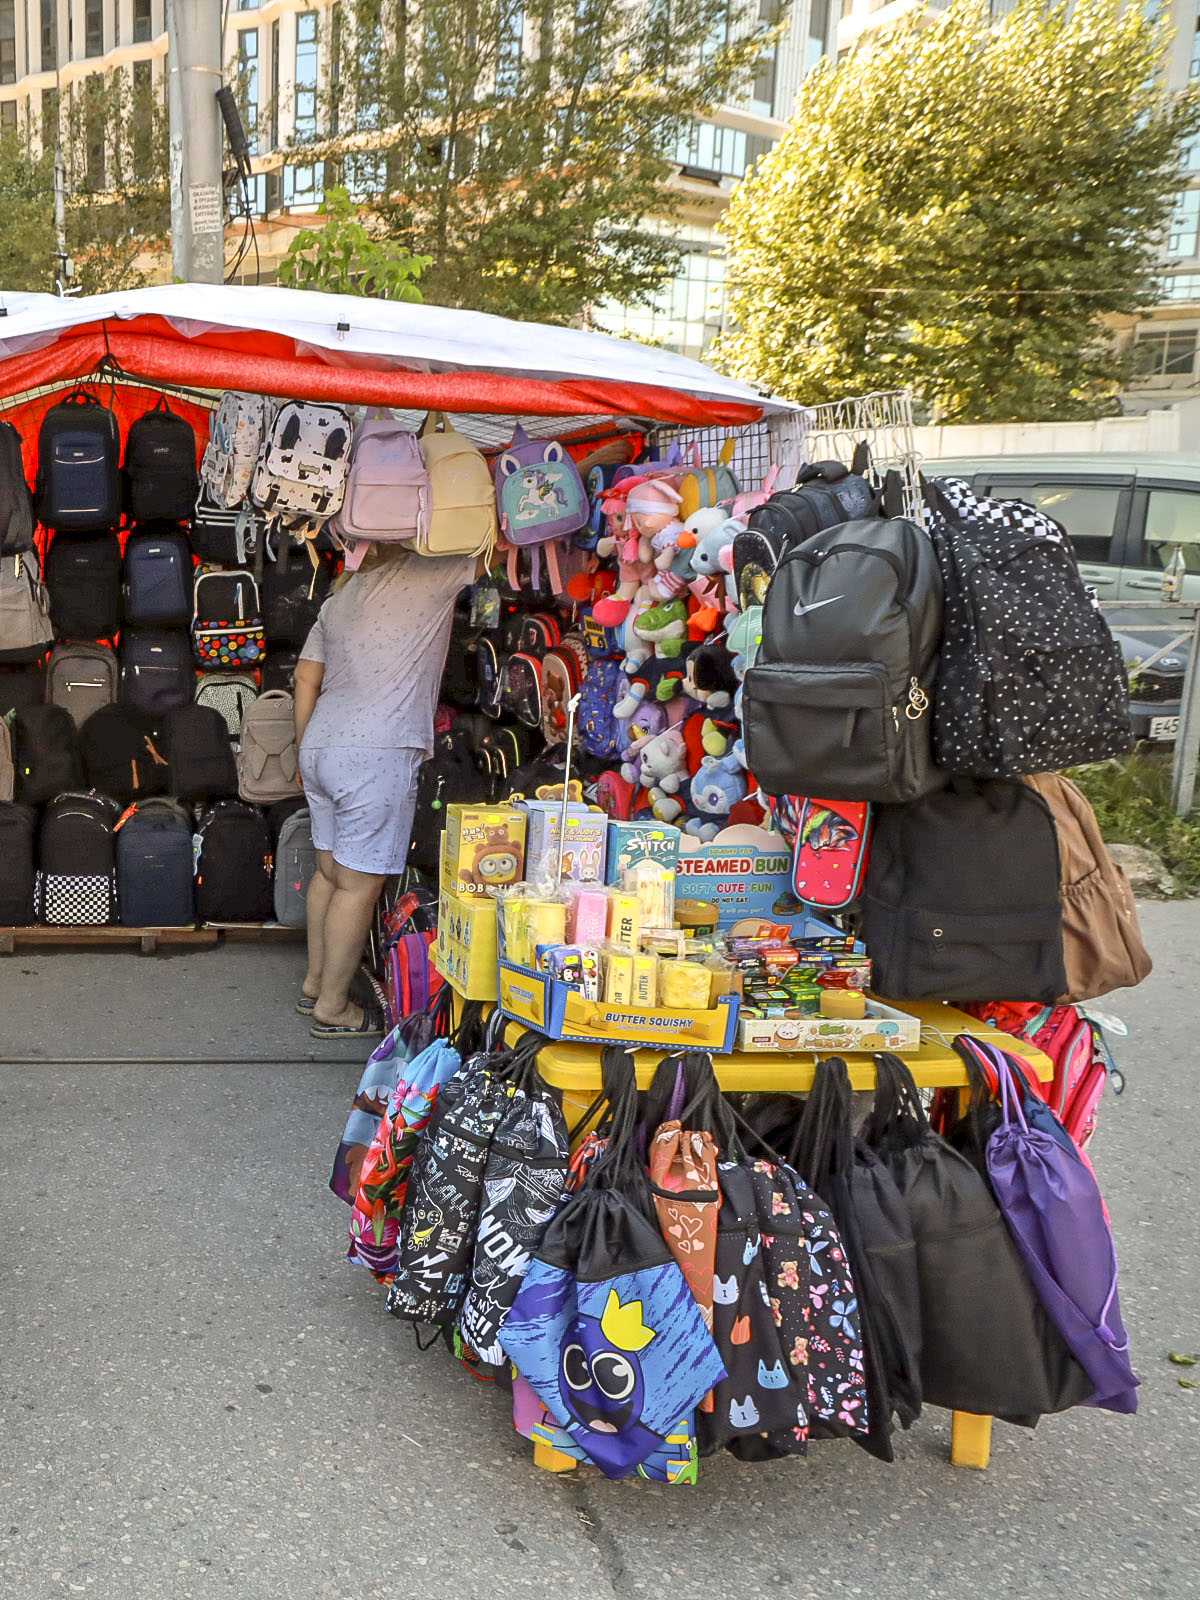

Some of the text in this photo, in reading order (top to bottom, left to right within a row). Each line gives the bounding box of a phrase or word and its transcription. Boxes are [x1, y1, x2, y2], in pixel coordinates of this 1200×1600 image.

[626, 838, 676, 852] STITCH
[754, 857, 789, 873] BUN
[459, 883, 484, 893] BOB
[638, 975, 649, 1001] BUTTER
[605, 1013, 694, 1028] BUTTER SQUISHY
[477, 1214, 531, 1278] NOW
[477, 1299, 494, 1316] MY
